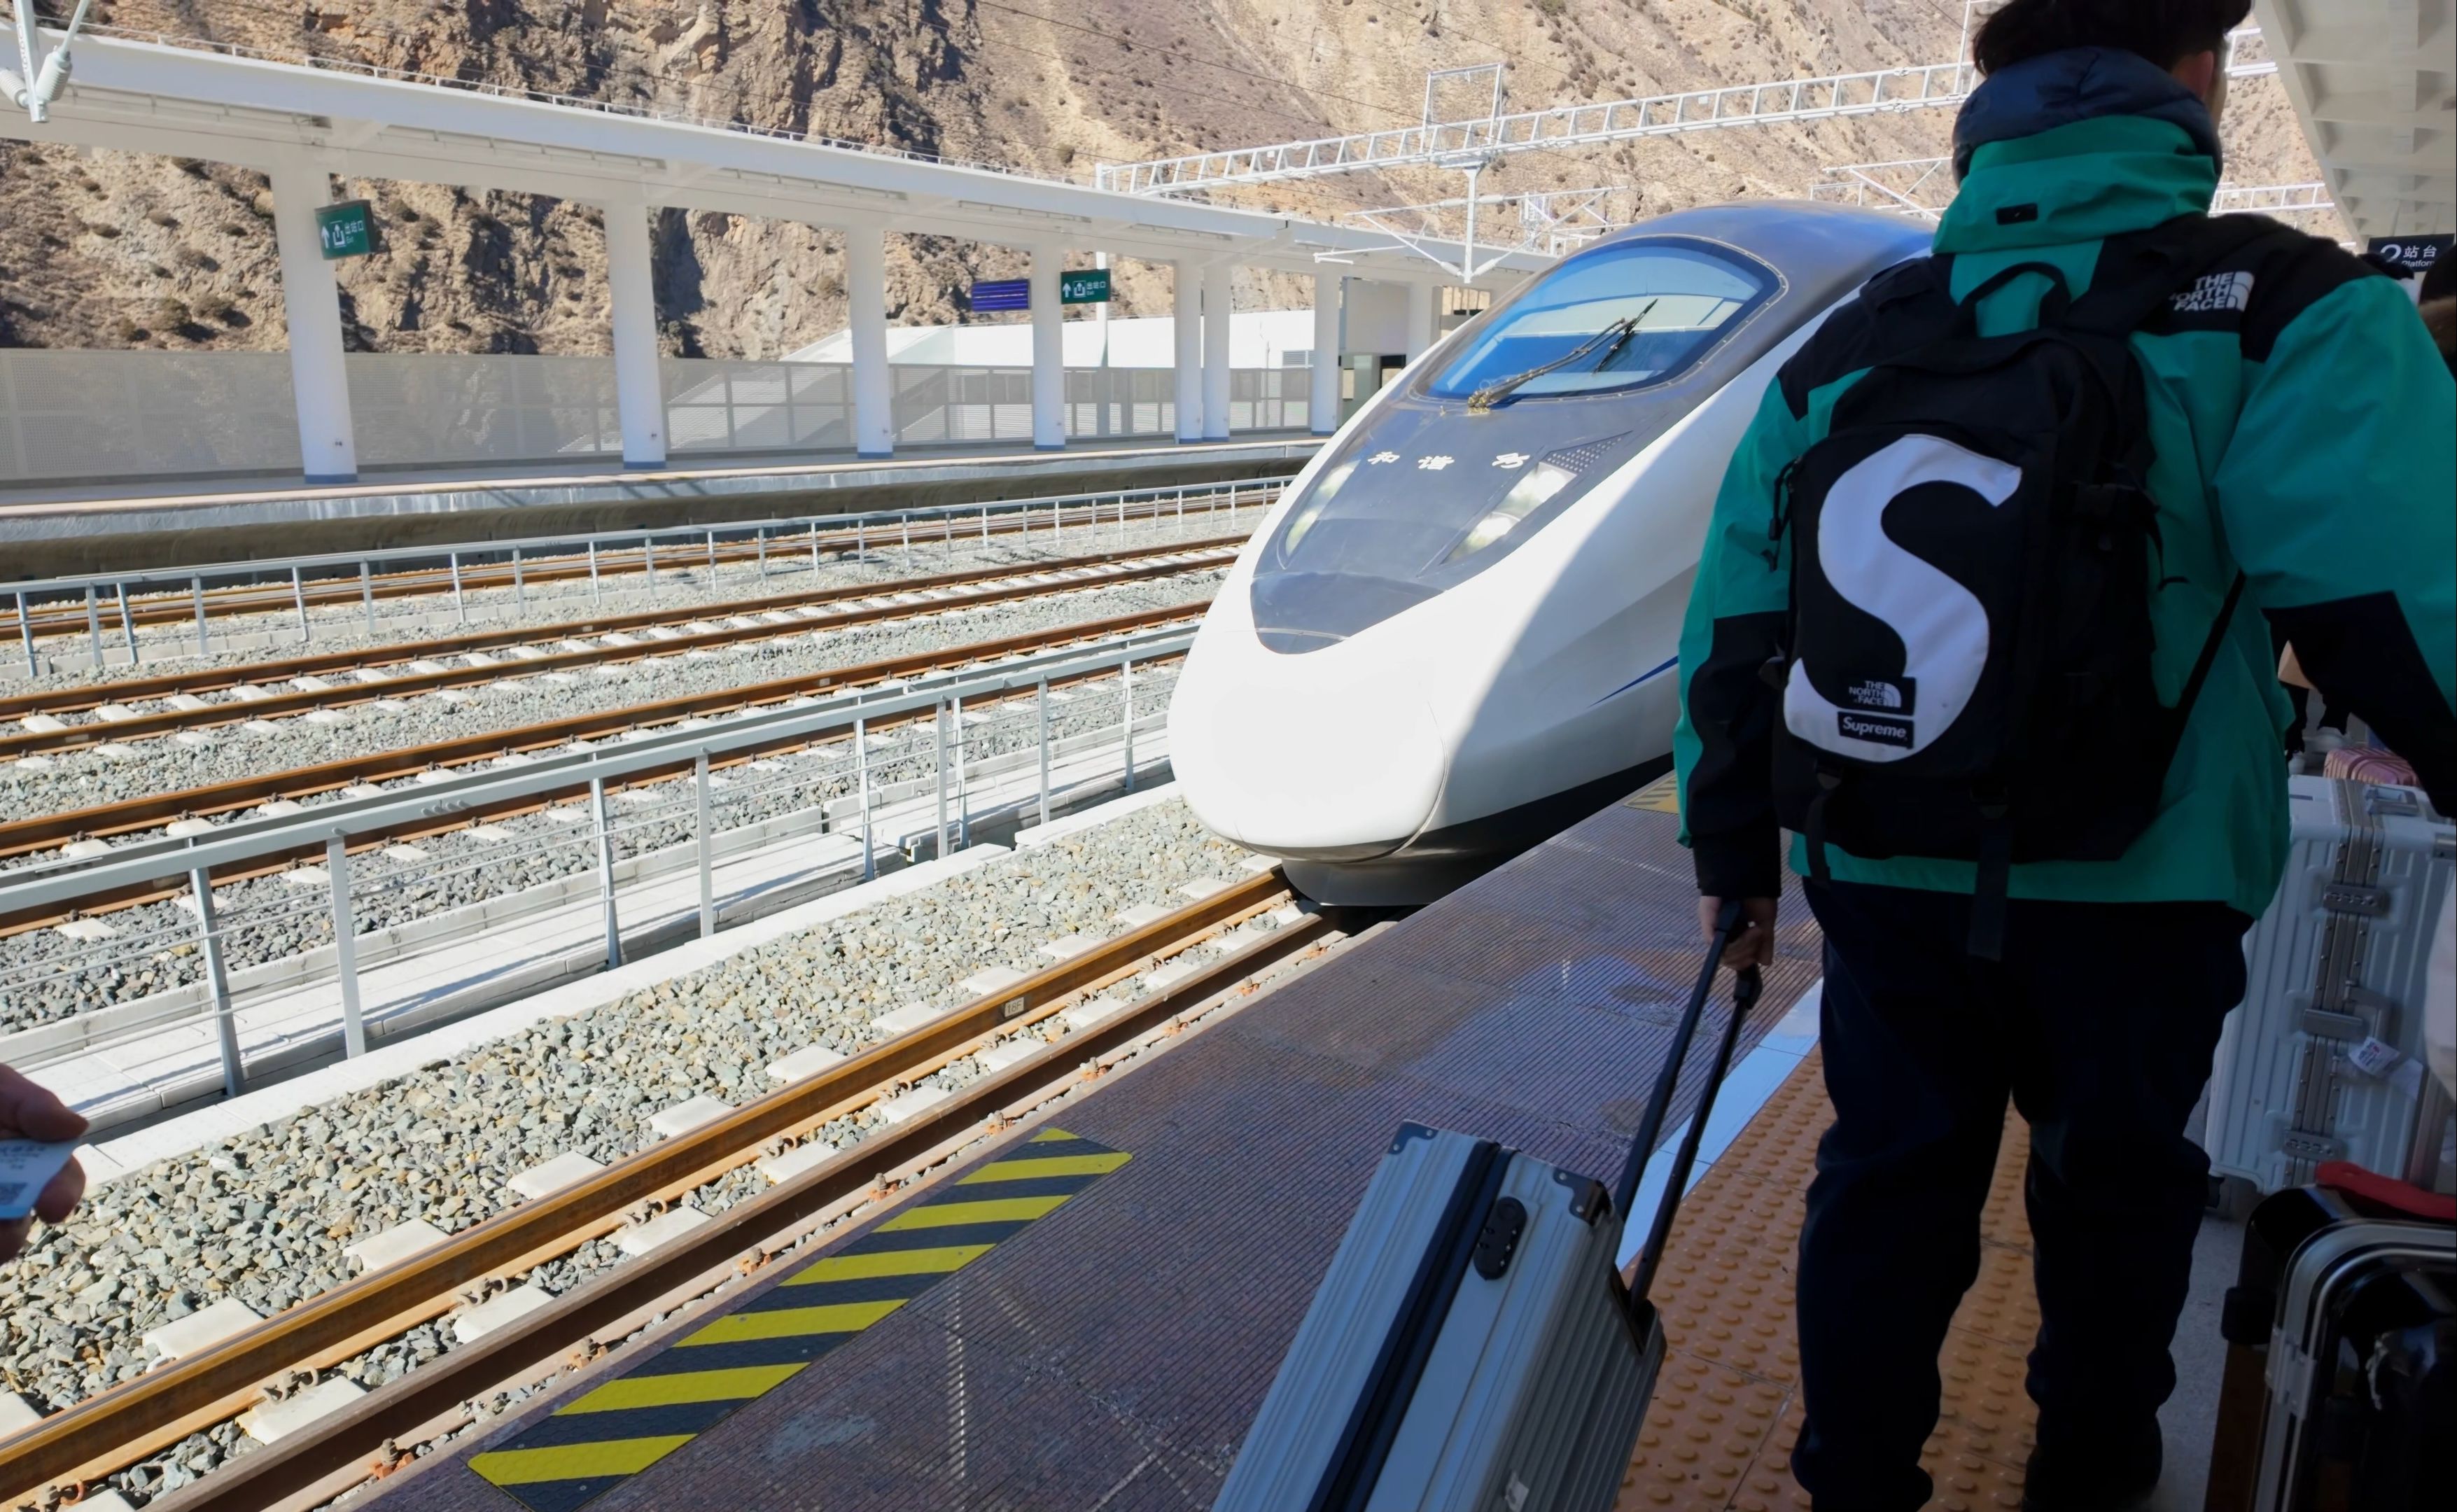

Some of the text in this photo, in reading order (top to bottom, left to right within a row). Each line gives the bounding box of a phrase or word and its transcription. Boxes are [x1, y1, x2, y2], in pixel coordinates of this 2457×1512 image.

[2403, 245, 2437, 258] 站台
[2195, 272, 2234, 290] THE
[2174, 296, 2227, 311] FACE
[1784, 433, 2022, 762] S
[1865, 680, 1884, 690] THE
[1849, 687, 1884, 698] NORTH
[1858, 695, 1884, 706] FACE
[1842, 716, 1907, 738] Supreme
